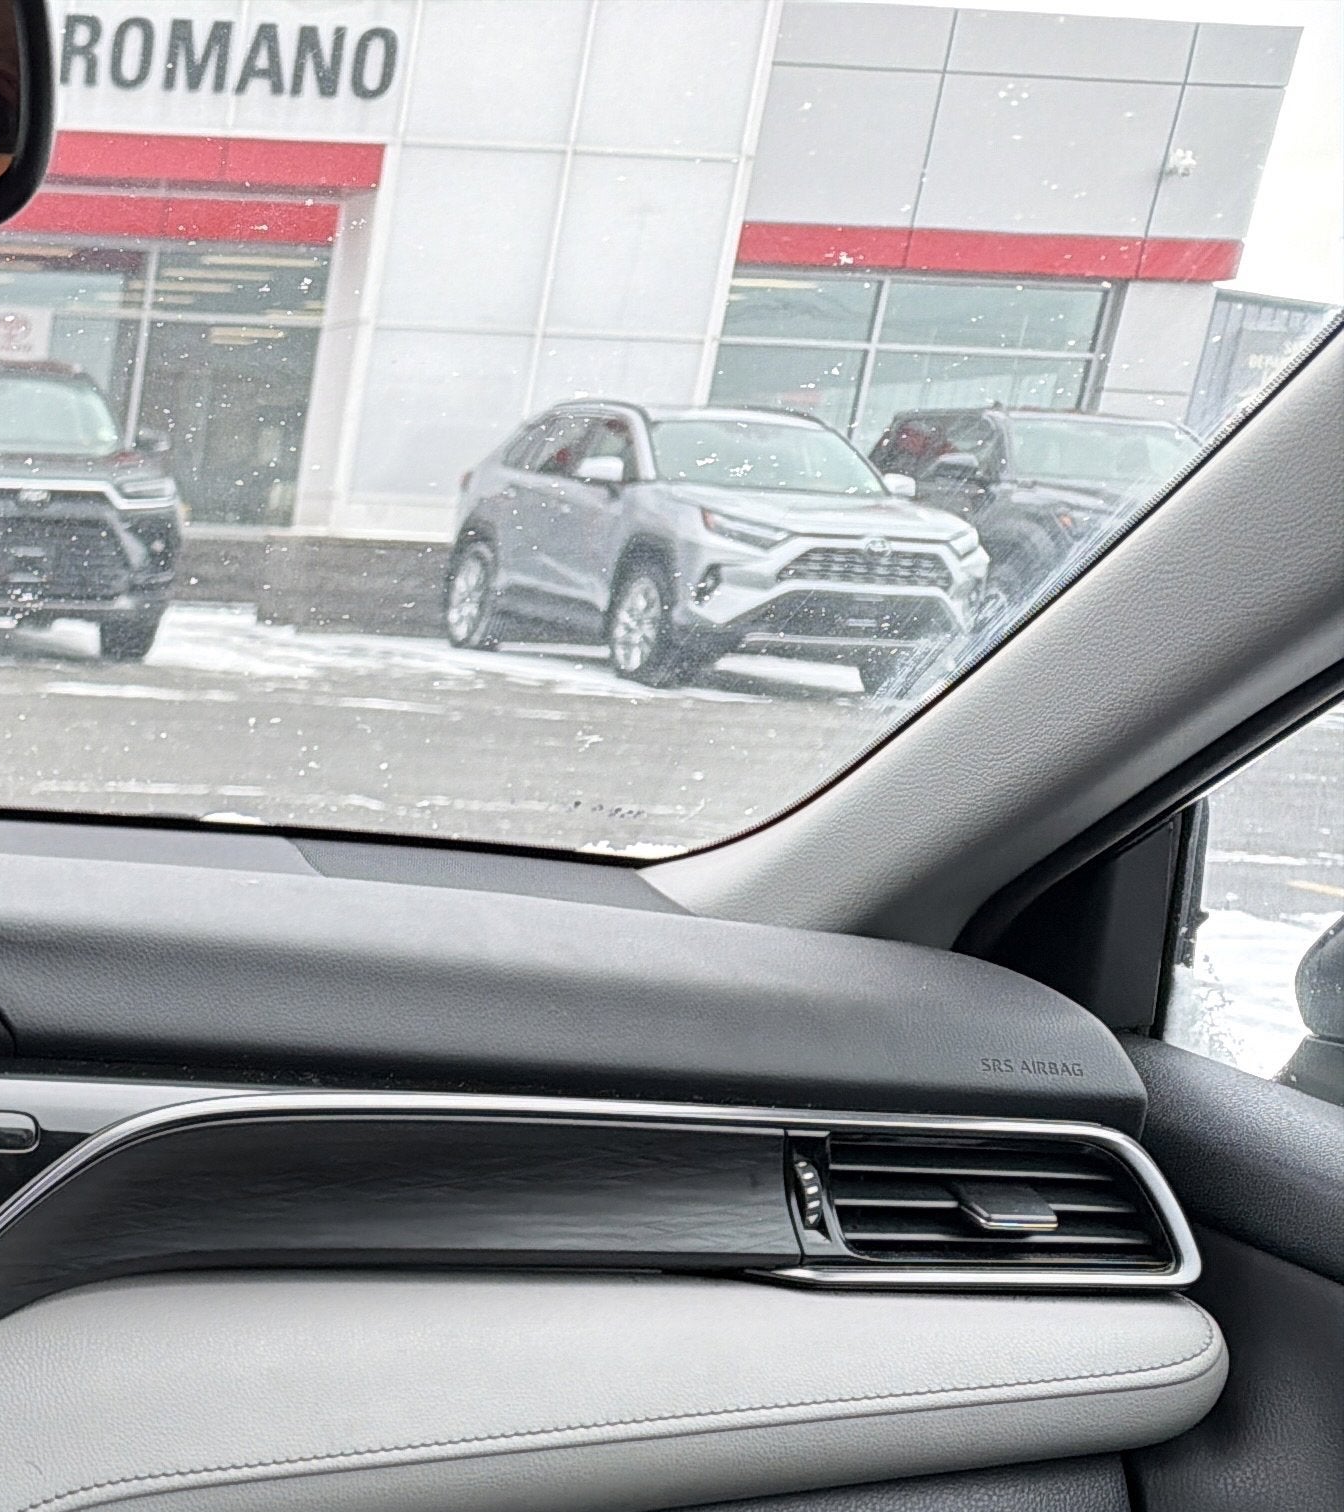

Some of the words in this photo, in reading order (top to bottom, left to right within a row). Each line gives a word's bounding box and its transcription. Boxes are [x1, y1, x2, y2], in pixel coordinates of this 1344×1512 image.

[60, 14, 399, 99] ROMANO
[980, 1058, 1014, 1073] SRS
[1021, 1060, 1084, 1077] AIRBAG
